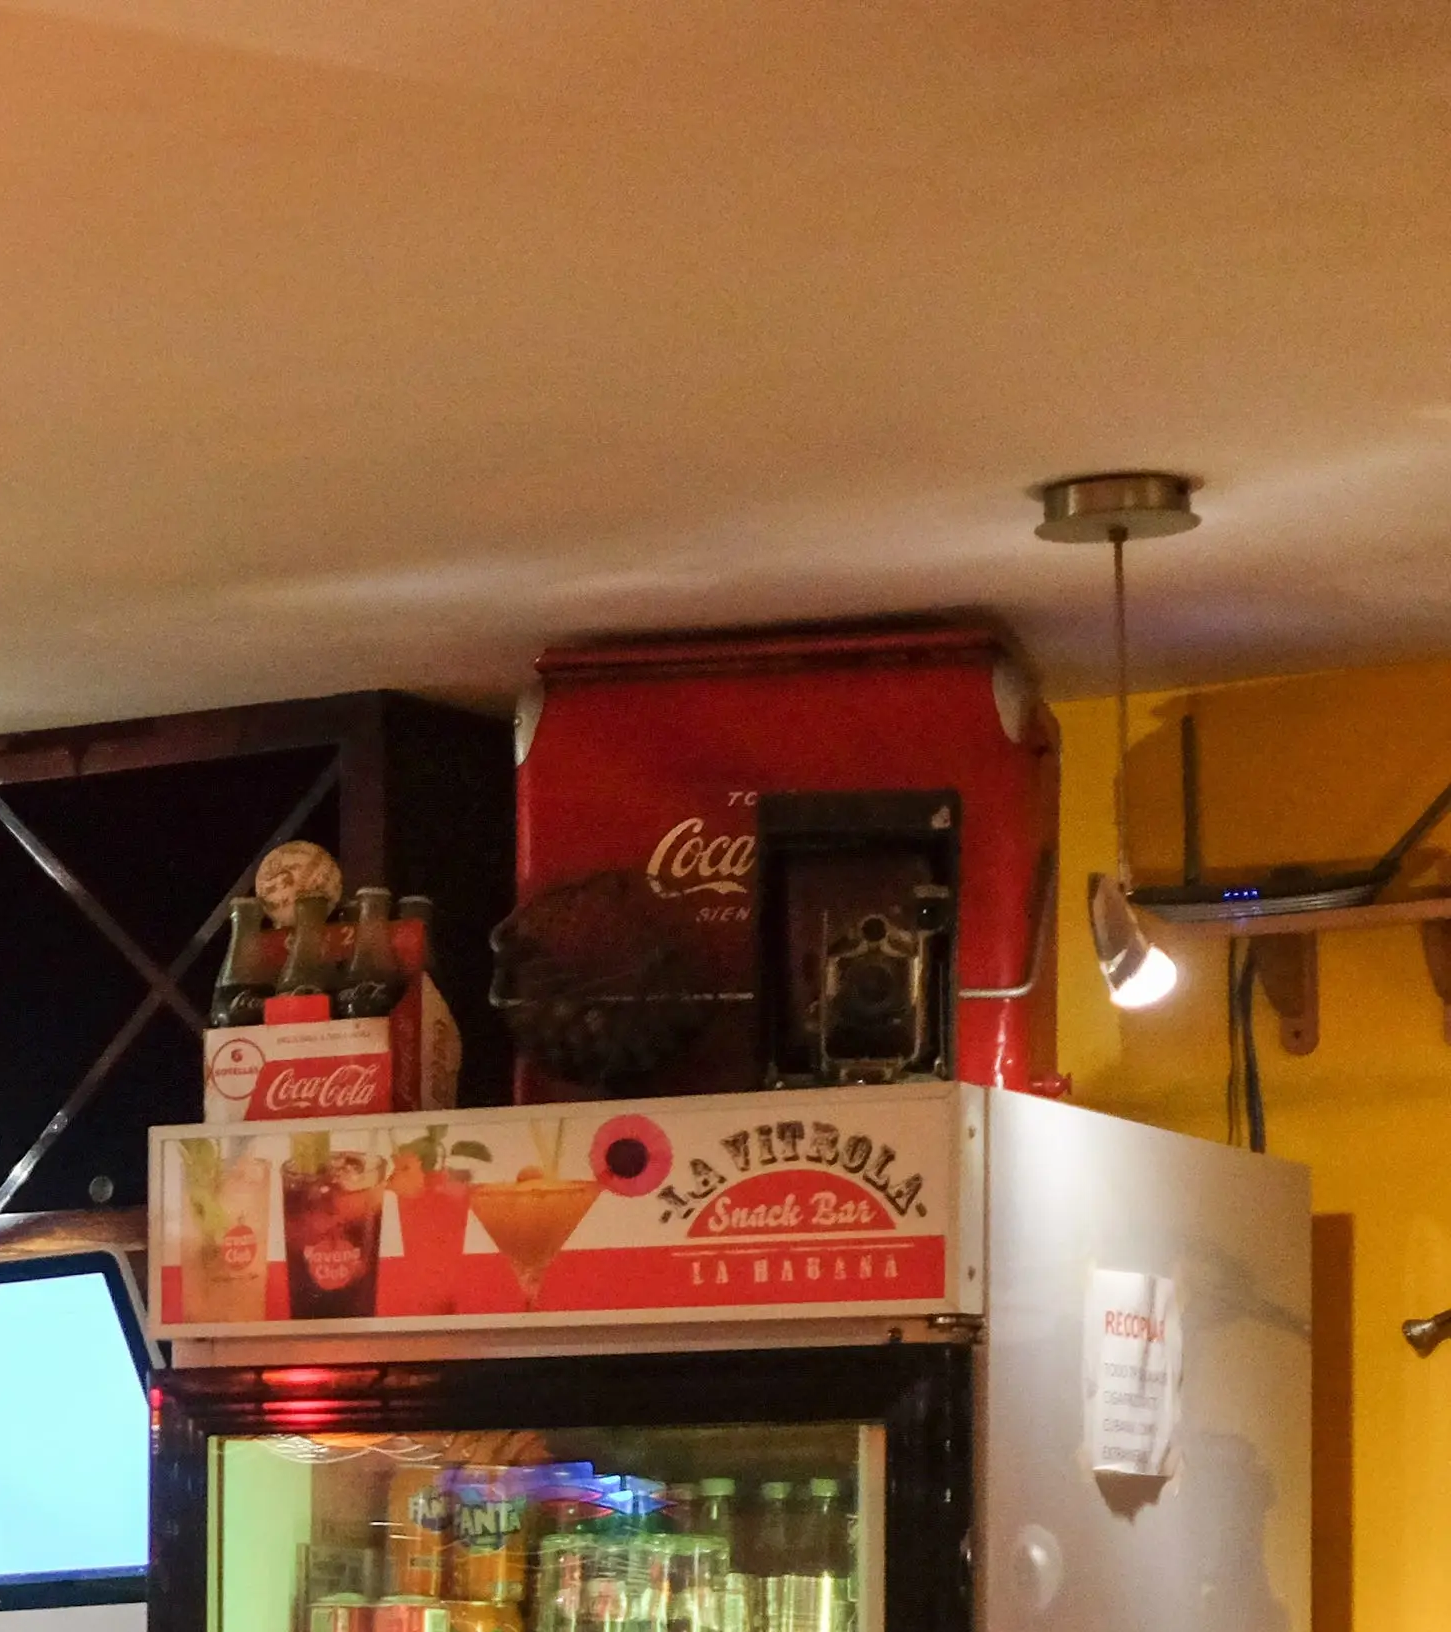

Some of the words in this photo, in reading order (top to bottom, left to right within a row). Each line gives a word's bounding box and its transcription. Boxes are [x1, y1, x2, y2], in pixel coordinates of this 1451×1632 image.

[231, 1050, 242, 1062] 6
[265, 1063, 380, 1111] Coca-Cola
[720, 1119, 924, 1217] VITROLA
[707, 1193, 804, 1233] Snack
[810, 1190, 877, 1226] Bar
